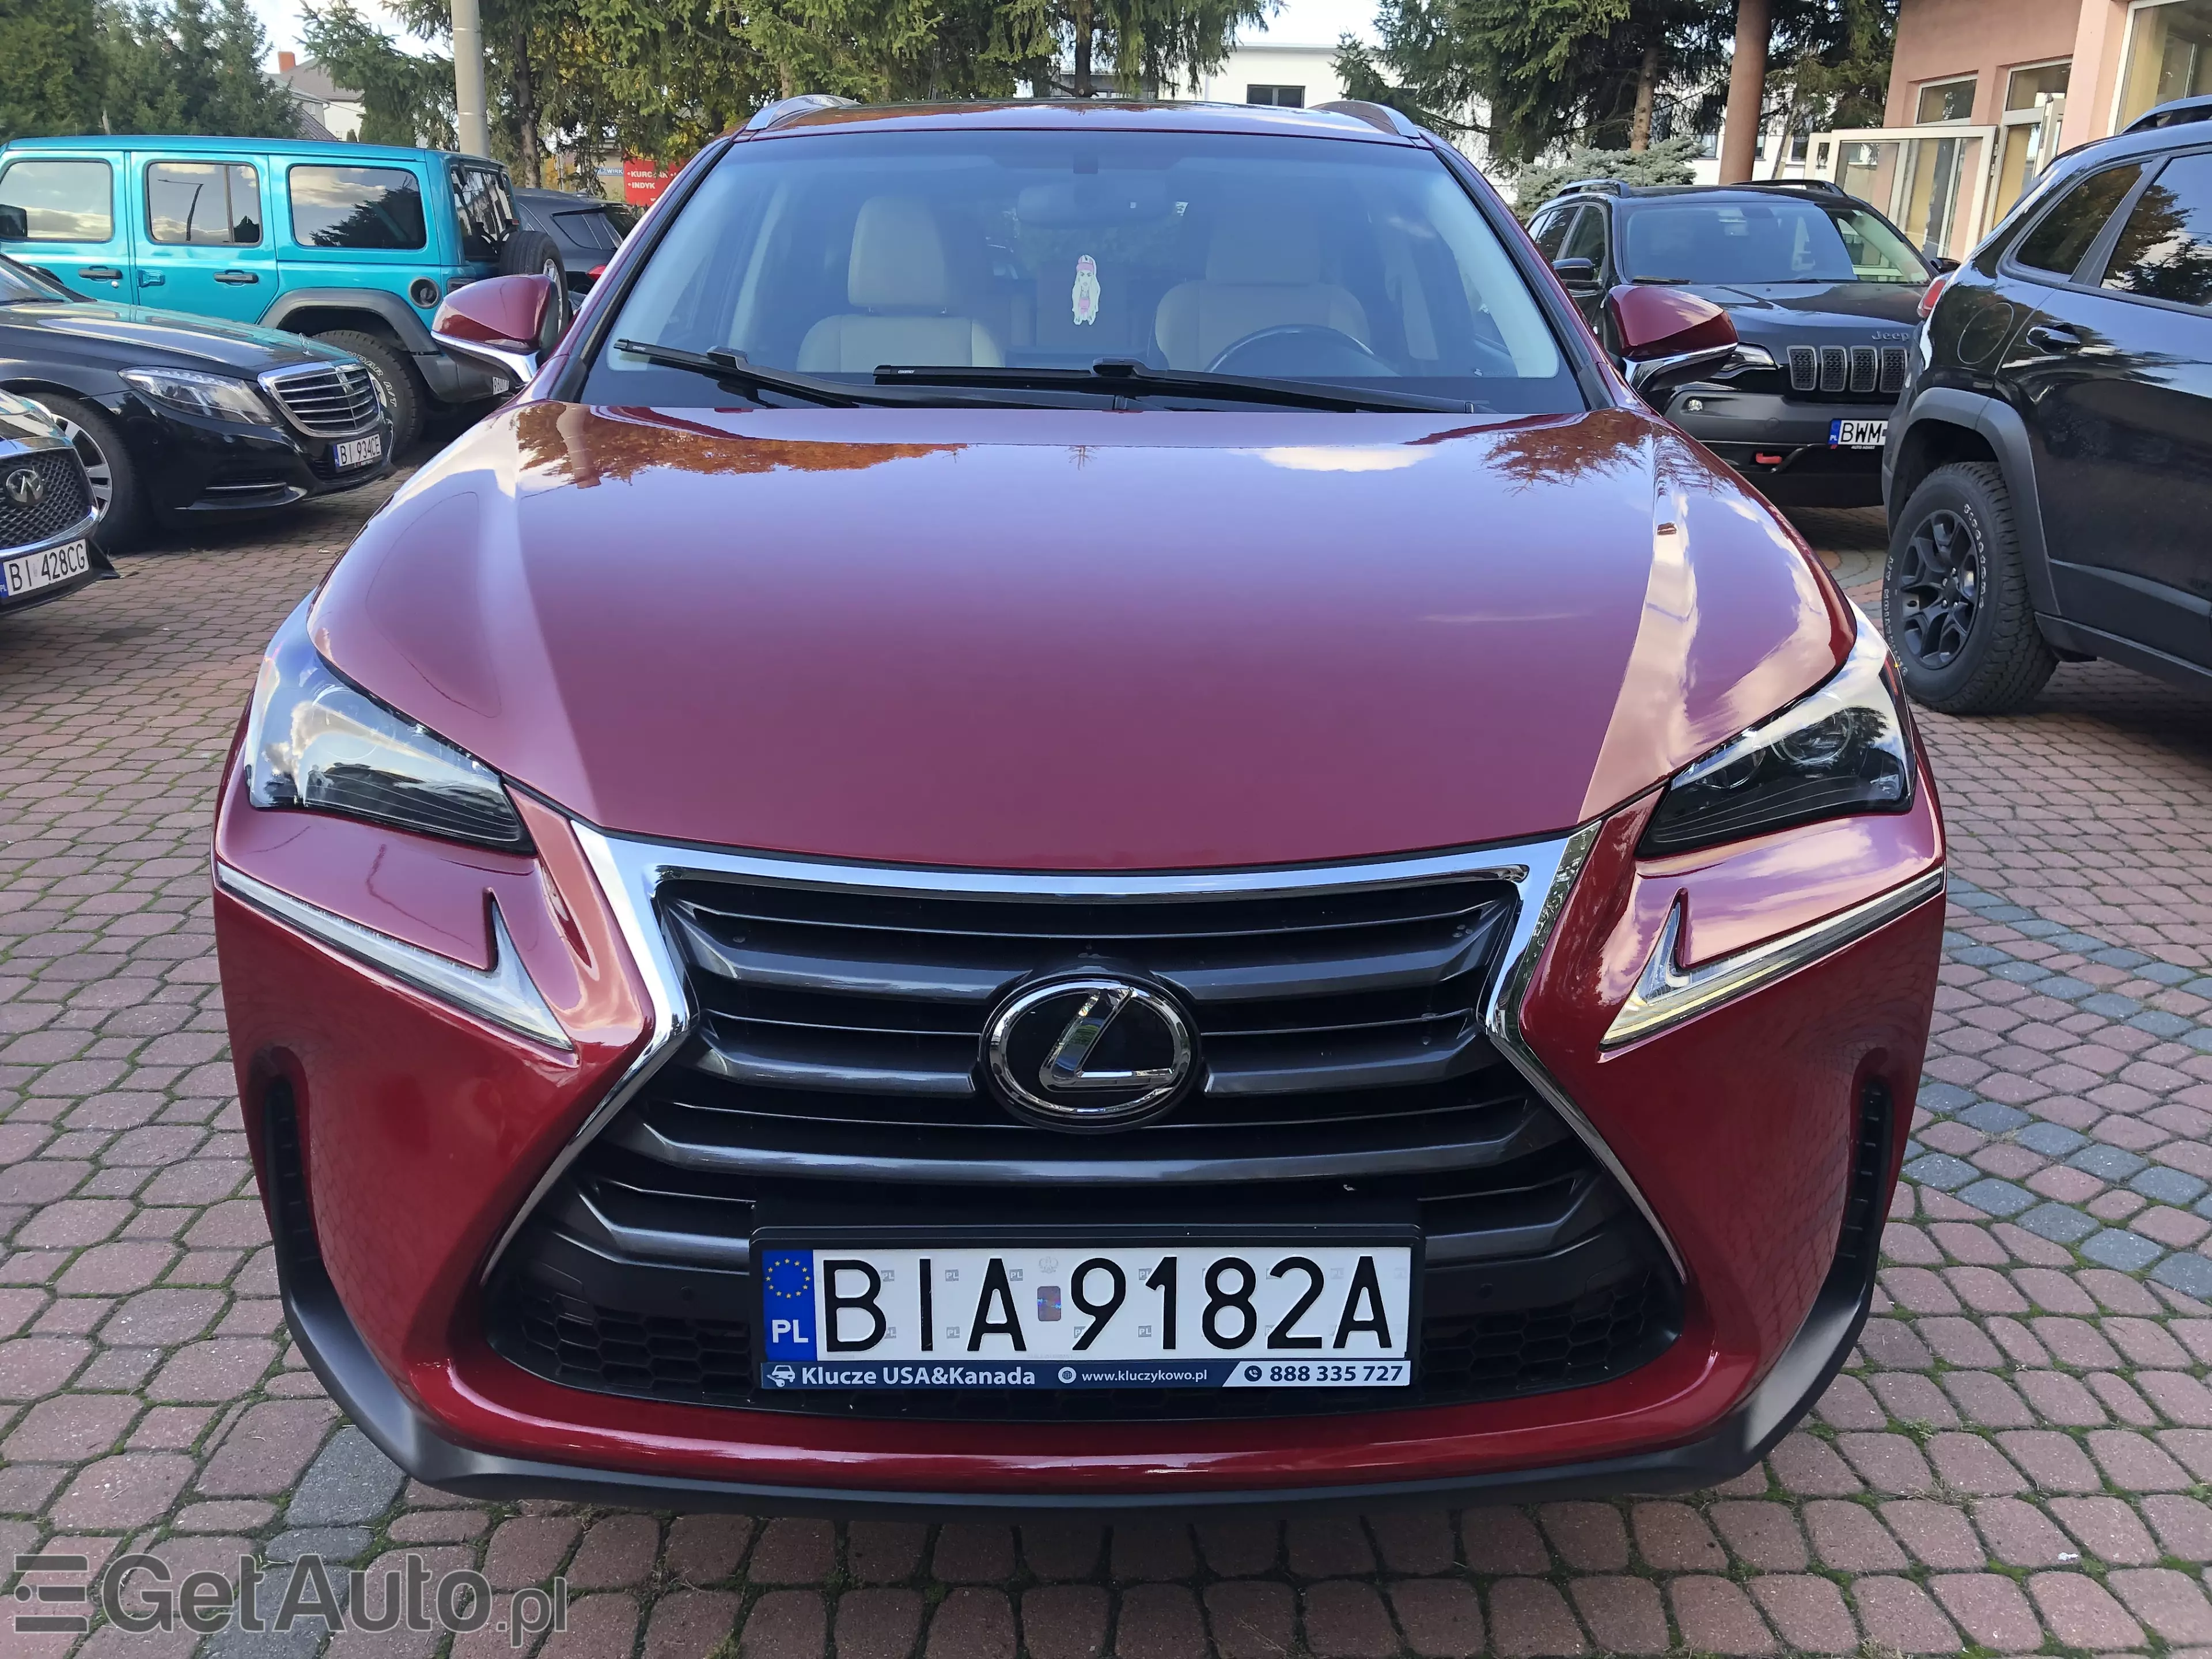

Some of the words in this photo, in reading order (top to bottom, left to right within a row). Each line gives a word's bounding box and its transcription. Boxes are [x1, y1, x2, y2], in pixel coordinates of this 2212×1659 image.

[1872, 331, 1909, 342] Jeep
[1841, 422, 1883, 443] BWM
[340, 444, 353, 464] BI
[357, 436, 380, 461] 934CE
[9, 559, 32, 592] BI
[41, 543, 85, 581] 428CG
[823, 1258, 1027, 1352] BIA
[1071, 1256, 1392, 1351] 9182A
[772, 1320, 809, 1343] PL
[802, 1366, 876, 1385] Klucze
[882, 1366, 1036, 1385] USA&Kanada
[1081, 1369, 1208, 1382] www.kluczykowo.pl
[1270, 1366, 1310, 1381] 888
[1316, 1366, 1357, 1381] 335
[1362, 1366, 1403, 1381] 727
